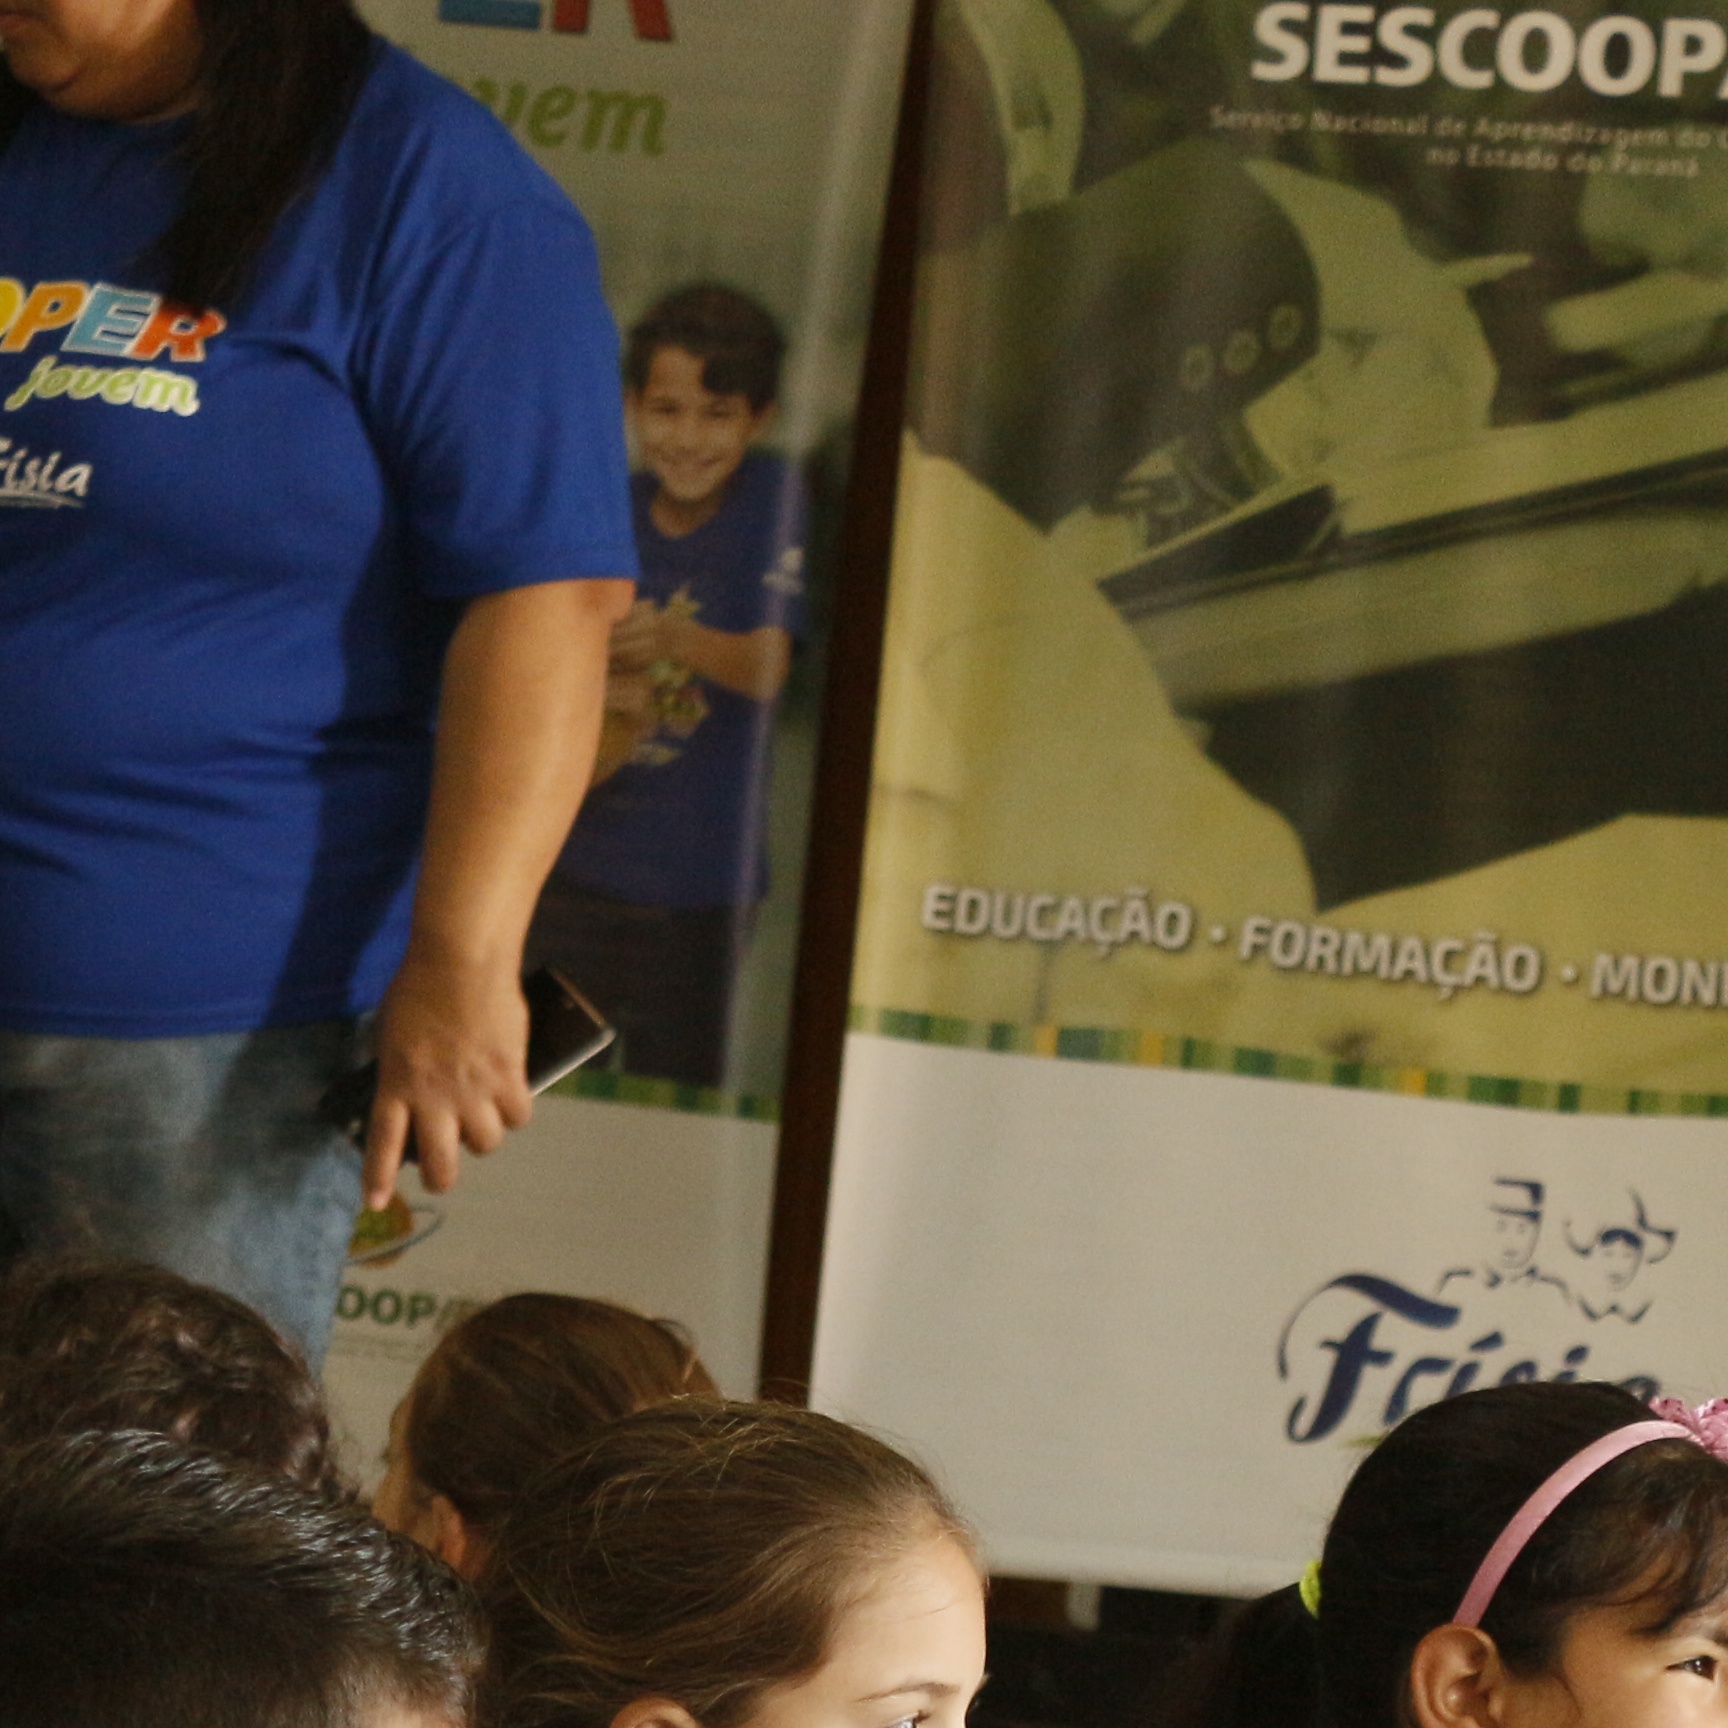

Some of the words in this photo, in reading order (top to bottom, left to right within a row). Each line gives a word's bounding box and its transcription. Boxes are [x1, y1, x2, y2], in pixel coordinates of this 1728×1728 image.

[1311, 110, 1428, 136] Nacional
[4, 355, 201, 416] jovem
[922, 883, 1194, 950] EDUCAÇÃO
[1240, 914, 1542, 1000] FORMAÇÃO
